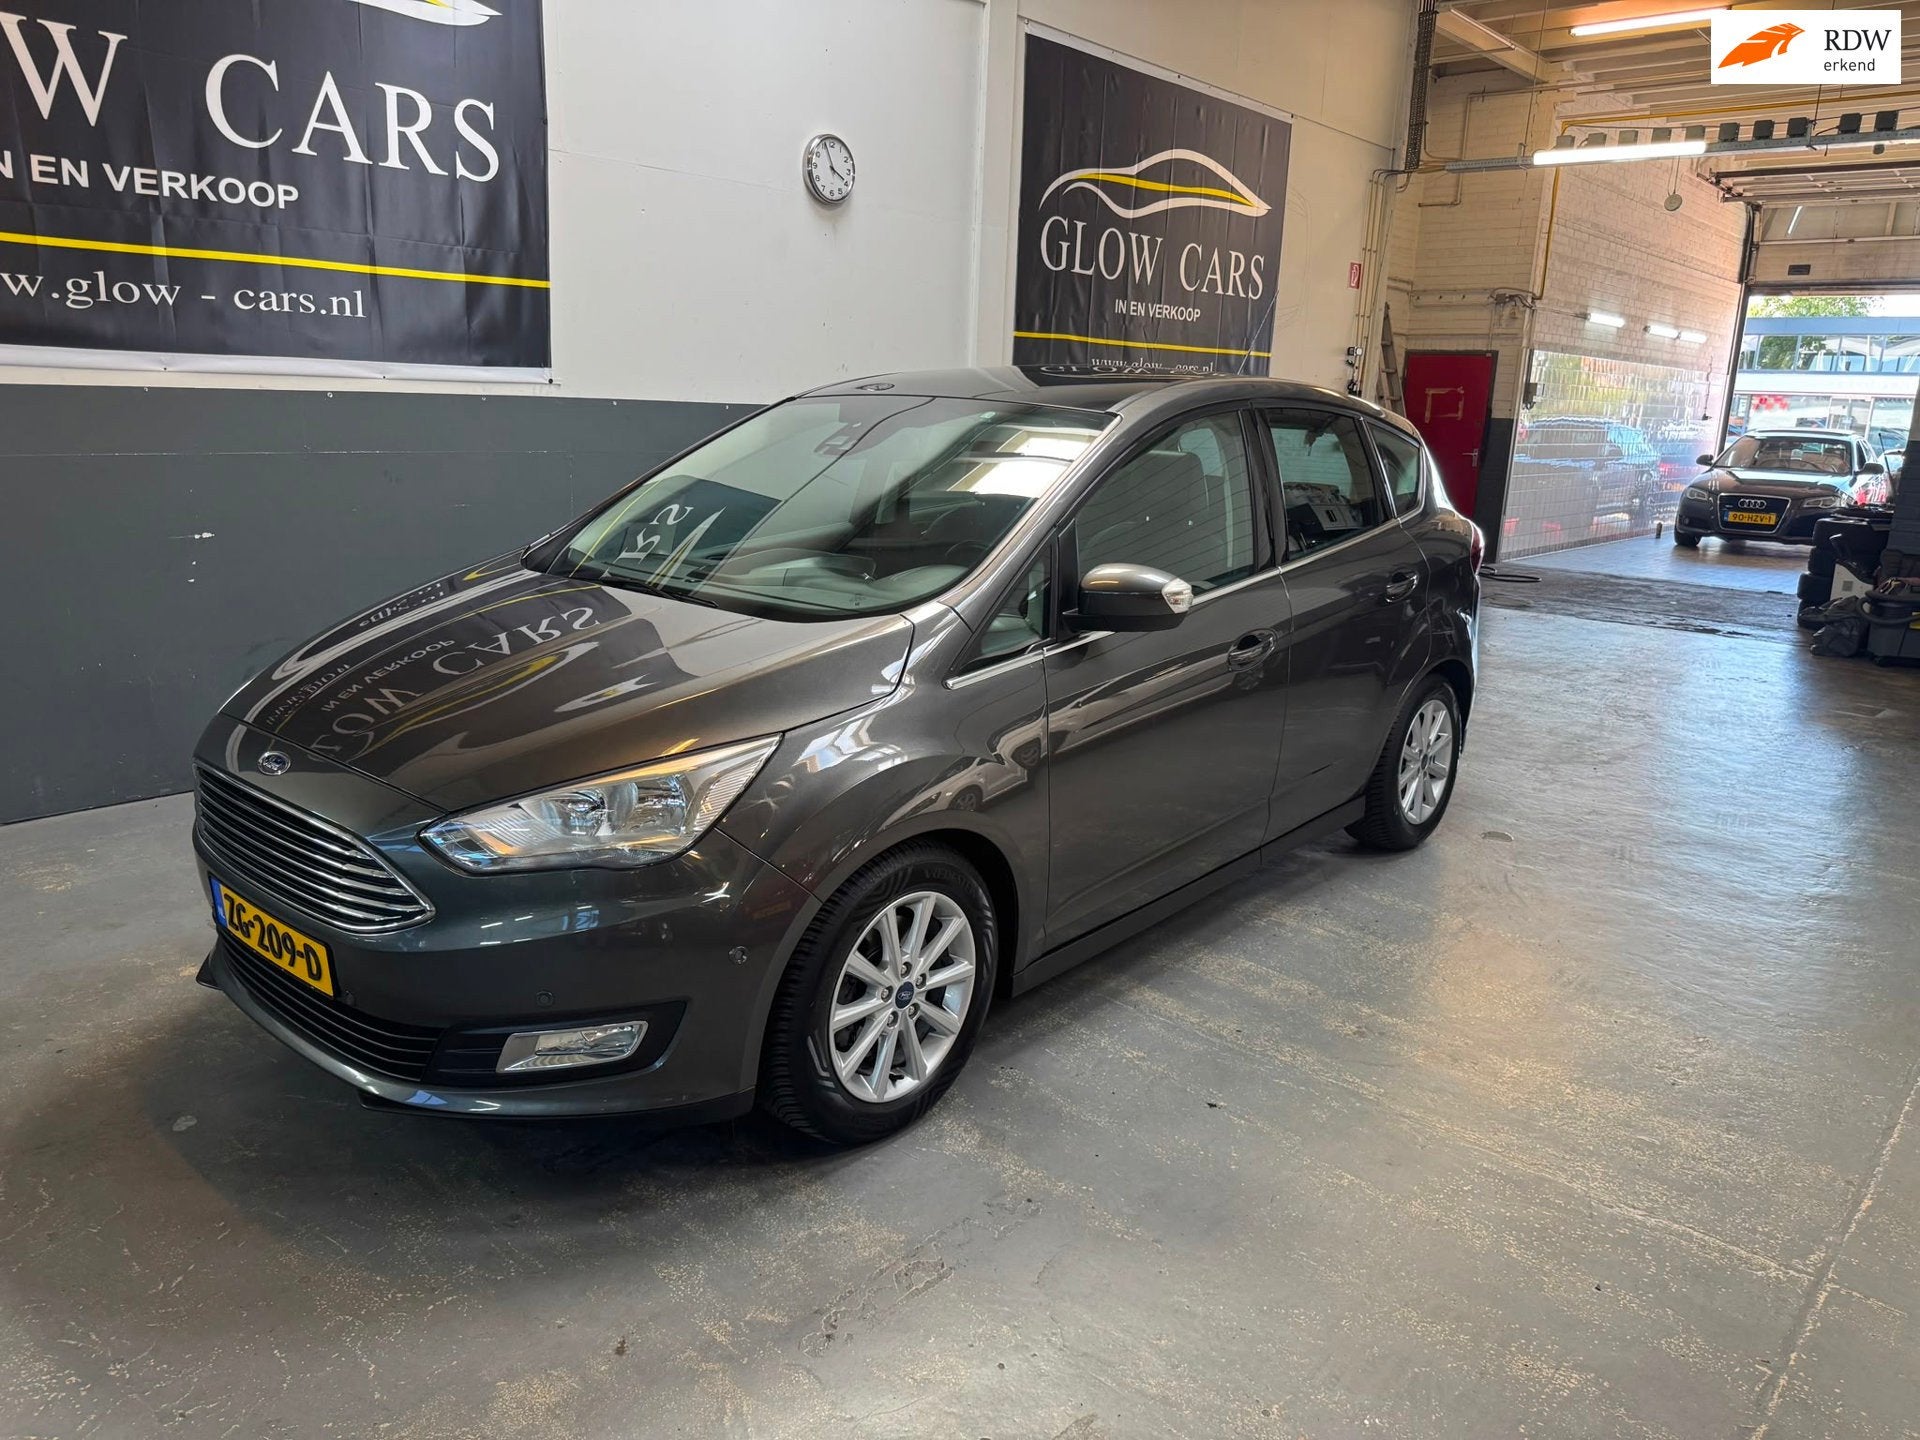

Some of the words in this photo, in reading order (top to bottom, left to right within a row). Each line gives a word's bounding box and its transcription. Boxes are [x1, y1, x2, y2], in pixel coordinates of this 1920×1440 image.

[205, 53, 499, 182] CARS
[30, 154, 89, 188] EN
[102, 163, 299, 209] VERKOOP
[1040, 215, 1163, 285] GLOW
[1179, 243, 1264, 299] CARS
[233, 289, 367, 319] cars.nl
[1115, 299, 1126, 314] IN
[1130, 302, 1145, 317] EN
[1148, 303, 1201, 322] VERKOOP
[1732, 513, 1772, 523] 90-HZV-1
[224, 893, 322, 981] ZG-209-D
